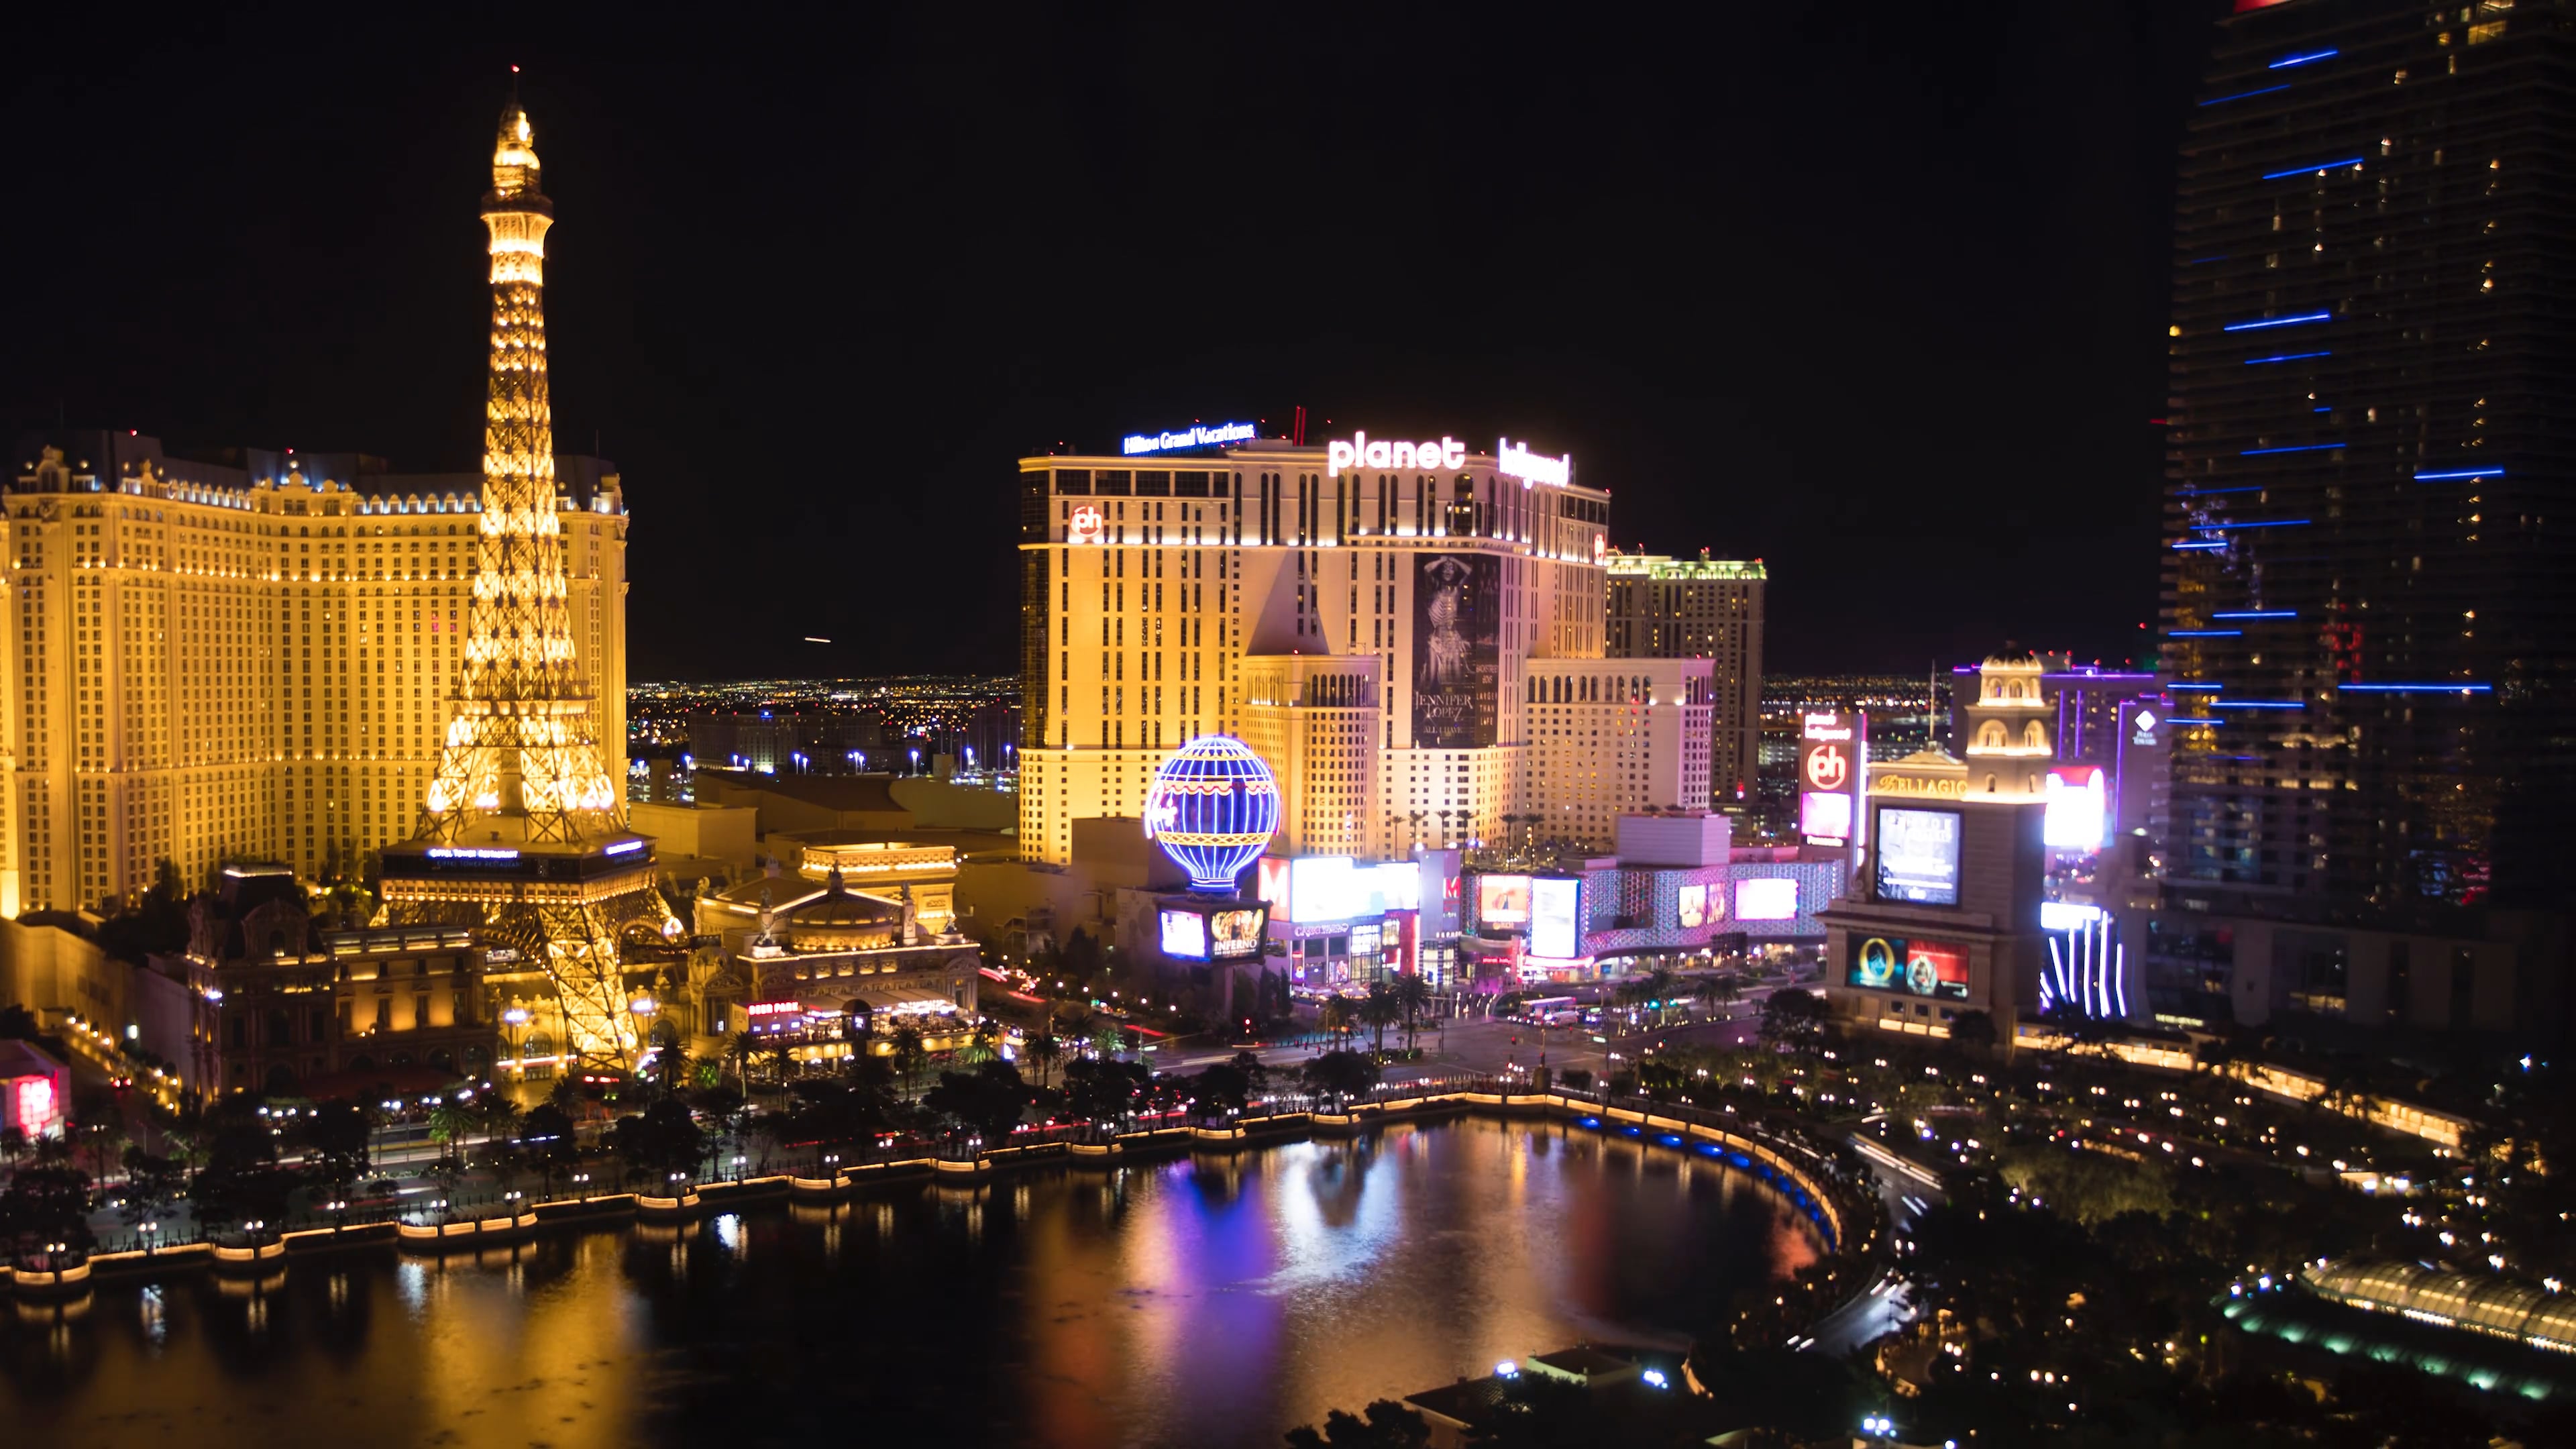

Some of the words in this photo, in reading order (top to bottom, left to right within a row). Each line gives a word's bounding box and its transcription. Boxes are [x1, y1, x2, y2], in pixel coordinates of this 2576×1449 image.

[1124, 435, 1159, 454] Hilton
[1160, 428, 1195, 449] Grand
[1196, 423, 1254, 444] Vacations
[1329, 431, 1465, 478] planet
[1072, 506, 1102, 535] ph
[1415, 691, 1473, 710] JENNIFER
[1479, 704, 1495, 712] THAN
[1425, 703, 1462, 722] LOPEZ
[1810, 745, 1846, 786] ph
[1878, 774, 1968, 796] BELLAGIO
[1260, 864, 1288, 907] M
[1443, 876, 1460, 899] M
[1214, 939, 1258, 951] INFERNO
[749, 1004, 773, 1015] BEER
[773, 1002, 799, 1013] PARK
